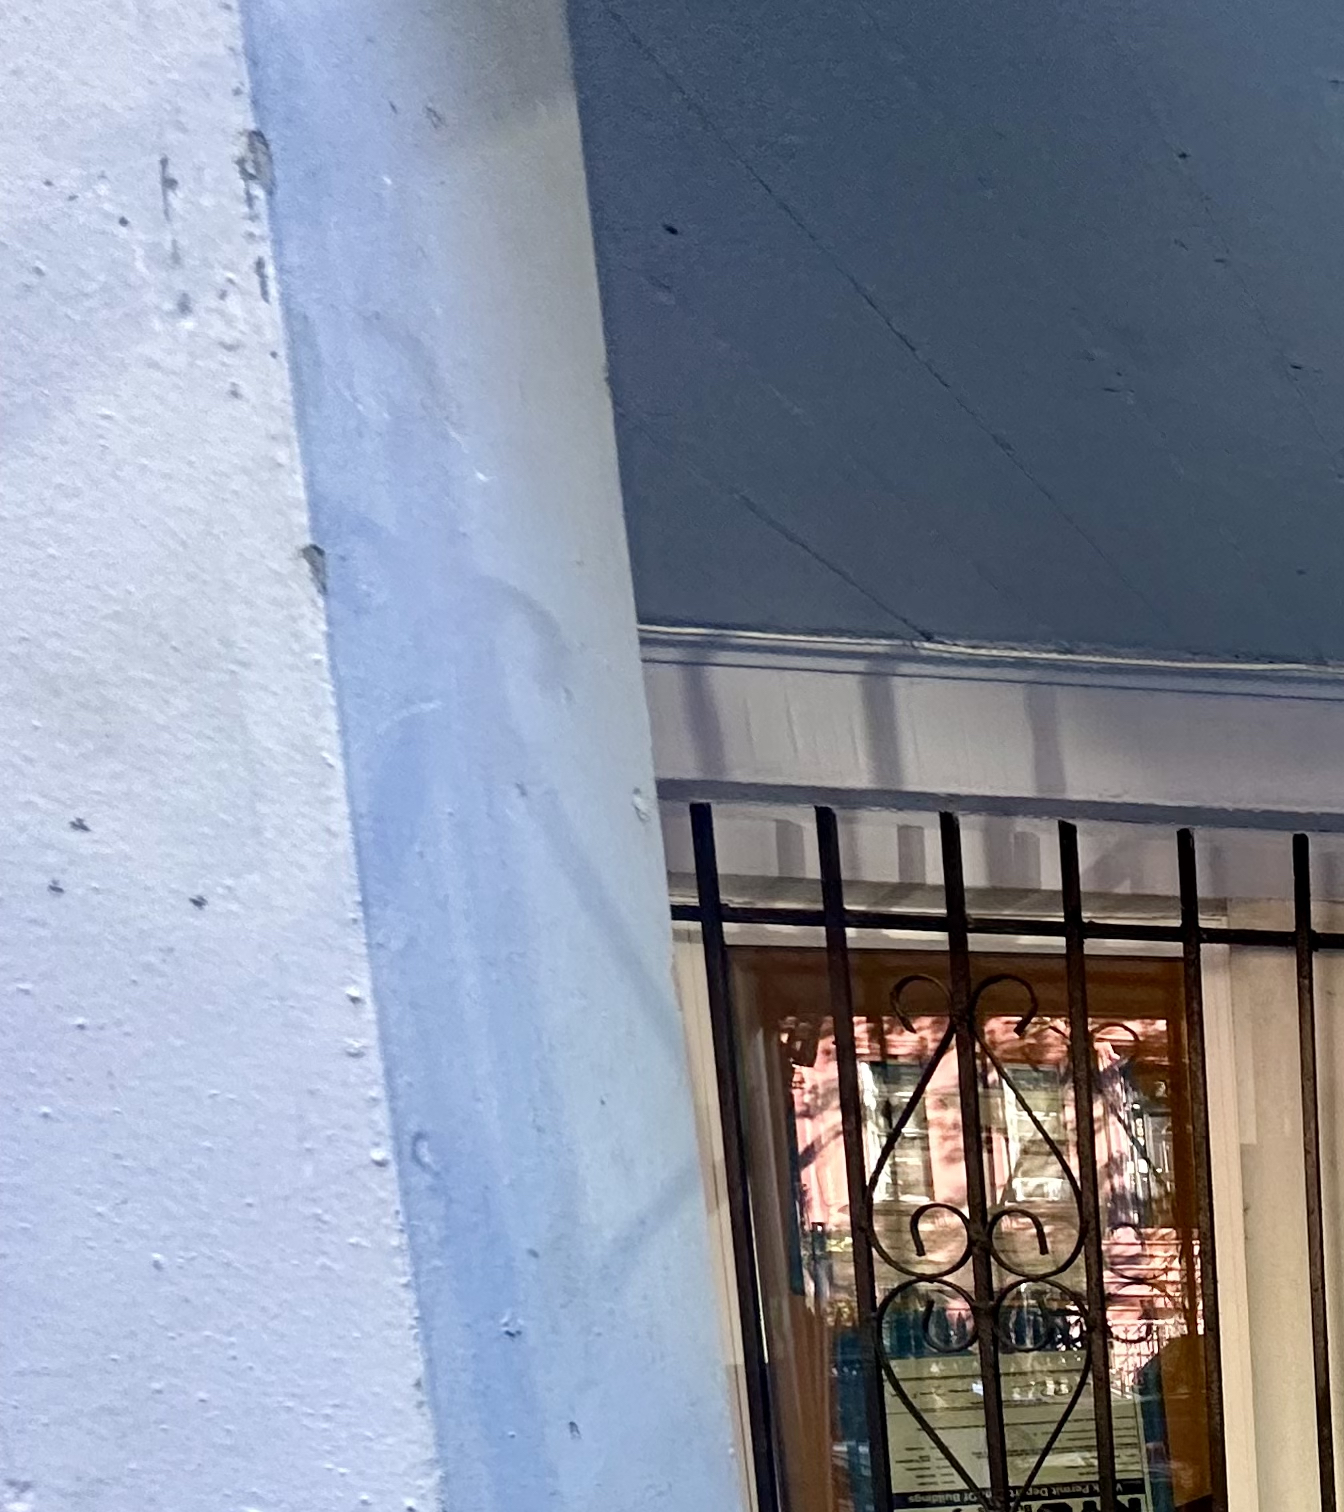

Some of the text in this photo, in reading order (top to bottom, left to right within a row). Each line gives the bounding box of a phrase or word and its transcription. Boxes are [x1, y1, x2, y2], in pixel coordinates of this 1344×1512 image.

[1051, 1484, 1089, 1496] Permit
[908, 1493, 960, 1504] Buildings
[963, 1492, 977, 1502] Of
